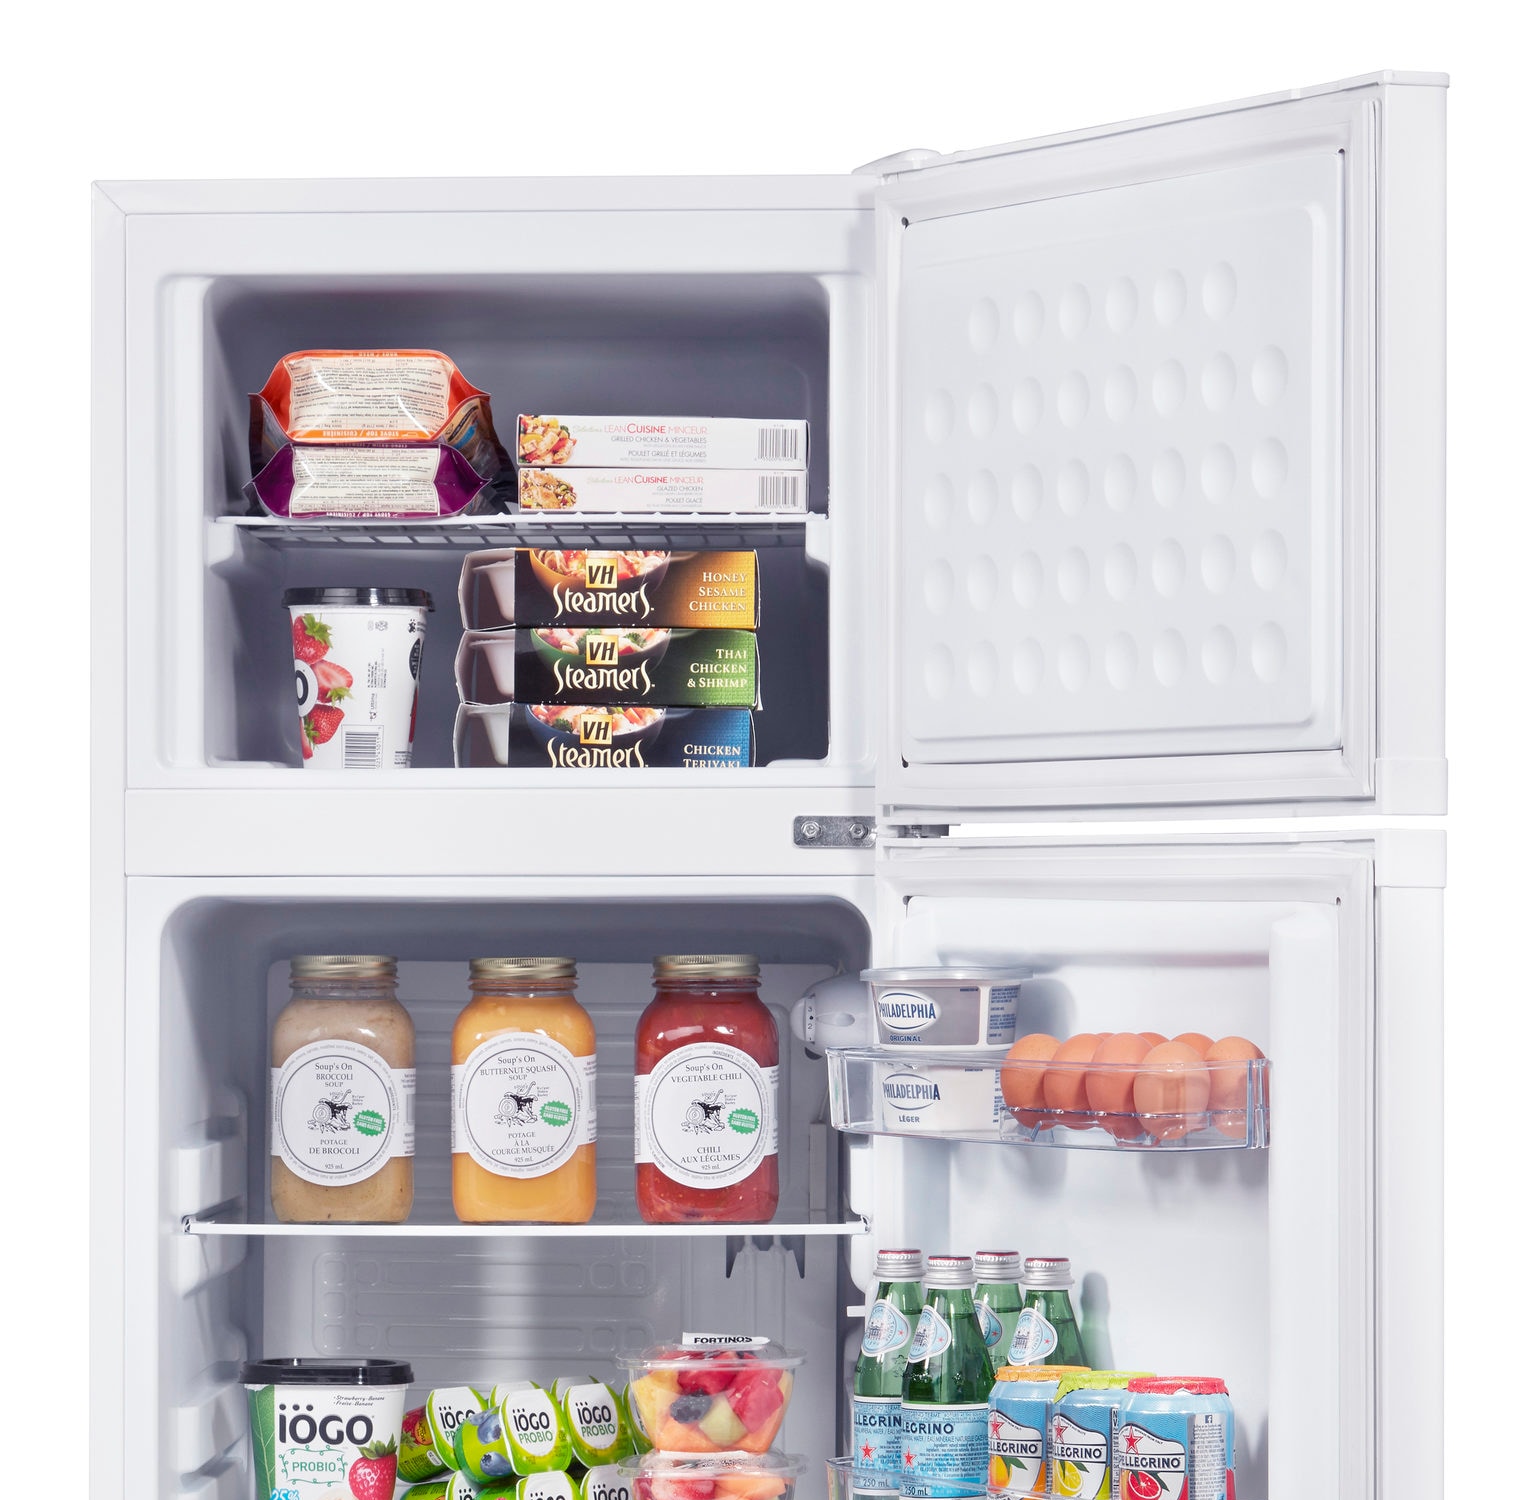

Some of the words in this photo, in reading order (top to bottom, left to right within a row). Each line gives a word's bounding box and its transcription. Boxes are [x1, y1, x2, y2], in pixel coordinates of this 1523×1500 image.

[668, 425, 708, 435] MINCEUR
[670, 476, 704, 484] MINCEUR
[588, 565, 615, 585] VH
[702, 571, 747, 583] HONEY
[698, 586, 747, 597] SESAME
[689, 600, 747, 612] CHICKEN
[588, 641, 616, 661] VH
[716, 648, 747, 660] THAI
[690, 662, 748, 674] CHICKEN
[687, 677, 697, 688] &
[699, 677, 748, 688] SHRIMP
[582, 721, 610, 740] VH
[683, 744, 741, 756] CHICKEN
[683, 758, 741, 768] TERIYAKI
[878, 1002, 937, 1020] PHILADELPHIA
[889, 1034, 922, 1042] ORIGINAL
[496, 1056, 522, 1066] Soup's
[523, 1054, 536, 1063] On
[314, 1062, 340, 1073] Soup's
[341, 1062, 353, 1071] On
[480, 1066, 524, 1076] BUTTERNUT
[525, 1064, 557, 1074] SQUASH
[685, 1063, 710, 1073] Soup's
[711, 1062, 723, 1071] On
[316, 1073, 354, 1081] BROCCOLI
[671, 1073, 718, 1083] VEGETABLE
[719, 1072, 743, 1081] CHILI
[882, 1082, 941, 1101] PHILADELPHIA
[898, 1114, 920, 1123] LÉGER
[508, 1131, 536, 1139] POTAGE
[309, 1147, 320, 1155] DE
[322, 1147, 360, 1155] BROCOLI
[491, 1147, 520, 1156] COURGE
[521, 1145, 556, 1154] MUSQUÉE
[696, 1146, 722, 1154] CHILI
[680, 1156, 698, 1164] AUX
[700, 1153, 741, 1163] LÉGUMES
[693, 1336, 753, 1345] FORTINOS
[855, 1415, 902, 1427] LLEGRIN
[581, 1424, 616, 1437] PROBIO
[902, 1421, 954, 1435] LEGRINO
[519, 1430, 553, 1443] PROBIO
[292, 1461, 337, 1472] PROBIO
[862, 1479, 876, 1487] 250
[904, 1486, 916, 1496] 250
